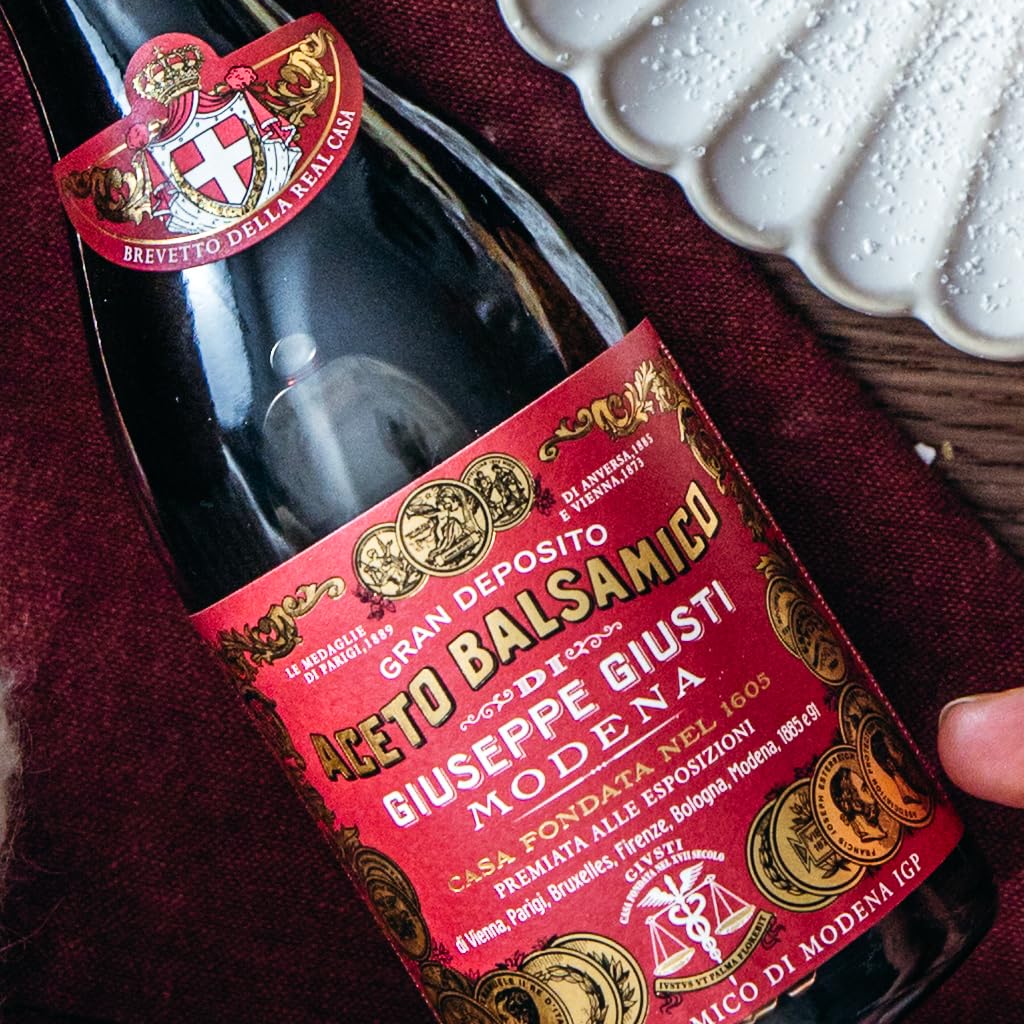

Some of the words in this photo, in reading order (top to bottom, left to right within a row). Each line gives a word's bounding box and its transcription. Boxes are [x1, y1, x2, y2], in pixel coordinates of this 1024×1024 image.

[123, 238, 221, 265] BREVETTO
[227, 199, 294, 246] DELLA
[290, 152, 335, 200] REAL
[327, 109, 356, 150] CASA
[559, 508, 571, 522] E
[561, 486, 580, 504] DI
[379, 605, 452, 680] GRAN
[453, 523, 608, 612] DEPOSITO
[285, 663, 301, 679] LE
[300, 624, 367, 671] MEDAGLIE
[310, 667, 457, 782] ACETO
[448, 480, 723, 691] BALSAMICO
[303, 671, 320, 685] DI
[512, 653, 572, 697] DI
[382, 678, 600, 829] GIUSEPPE
[599, 579, 736, 693] GIUSTI
[802, 712, 811, 726] e
[806, 701, 822, 721] 91
[467, 666, 707, 832] MODENA
[776, 715, 805, 745] 1885
[448, 850, 516, 893] CASA
[519, 762, 655, 853] FONDATA
[656, 719, 717, 762] NEL
[720, 672, 771, 718] 1605
[727, 740, 782, 784] Modena,
[493, 835, 589, 899] PREMIATA
[590, 799, 641, 843] ALLE
[640, 718, 756, 807] ESPOSIZIONI
[669, 777, 732, 824] Bologna,
[614, 818, 674, 860] Firenze,
[624, 838, 684, 883] GIVSTI
[547, 853, 619, 902] Bruxelles,
[506, 894, 552, 928] Parigi,
[763, 954, 797, 987] DI
[798, 881, 895, 962] MODENA
[891, 852, 922, 889] IGP
[455, 936, 468, 955] di
[464, 919, 511, 949] Vienna,
[709, 955, 739, 981] PALMA
